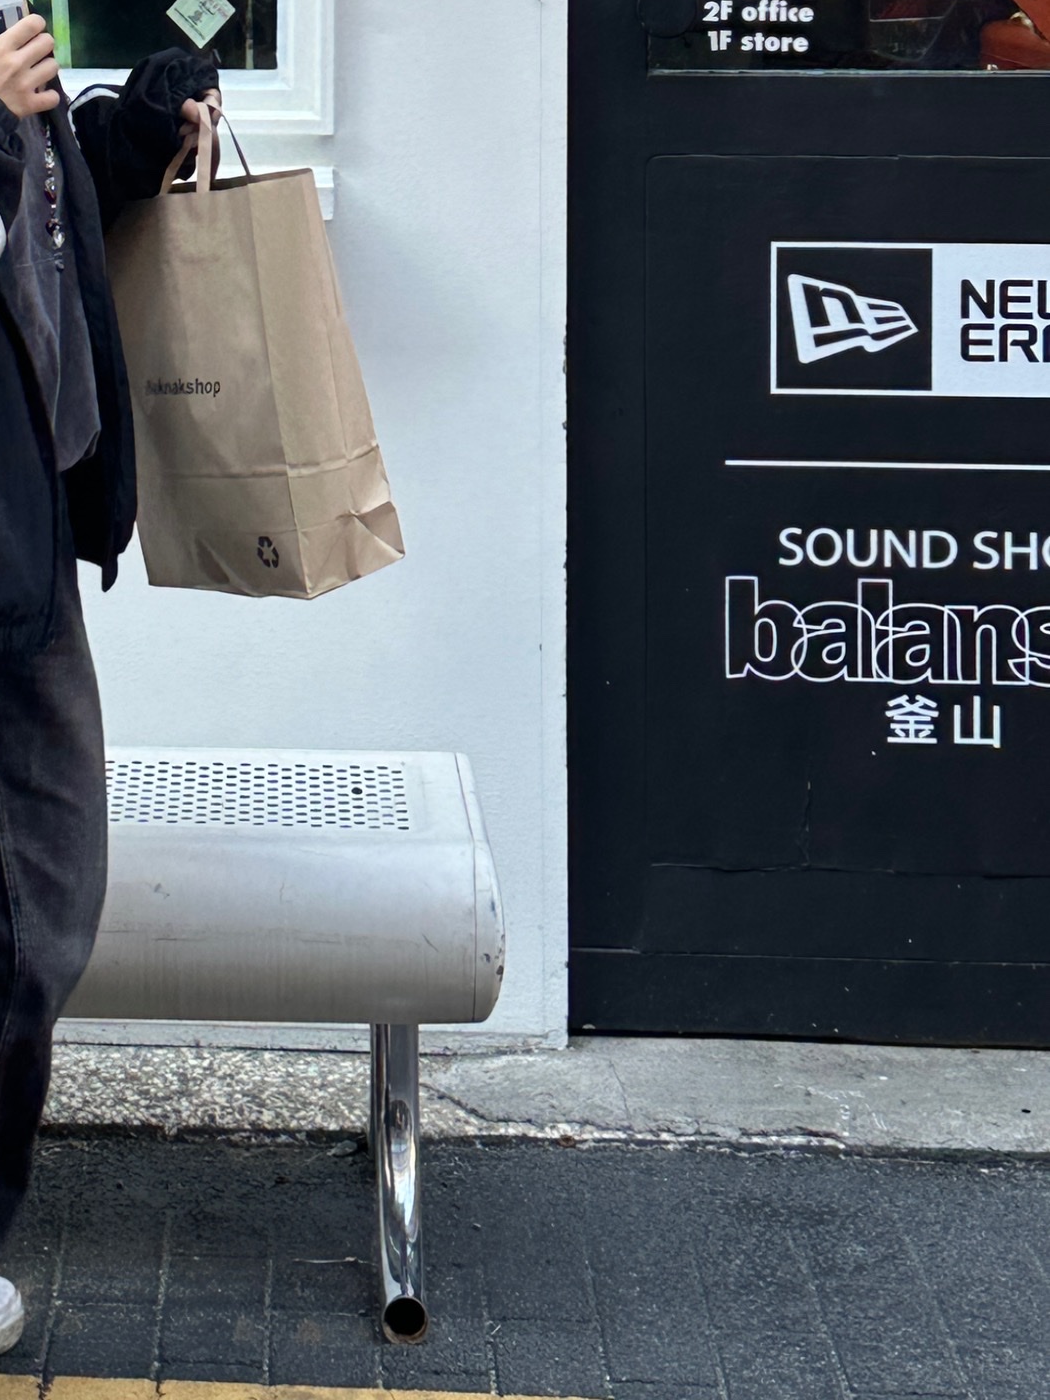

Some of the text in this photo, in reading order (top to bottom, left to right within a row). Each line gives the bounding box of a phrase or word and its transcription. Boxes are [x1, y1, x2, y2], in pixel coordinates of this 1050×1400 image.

[702, 0, 815, 22] 2F office
[707, 30, 809, 52] 1F store
[960, 323, 1050, 363] ER
[778, 526, 1050, 571] SOUND SH
[885, 694, 1001, 749] 釜山
